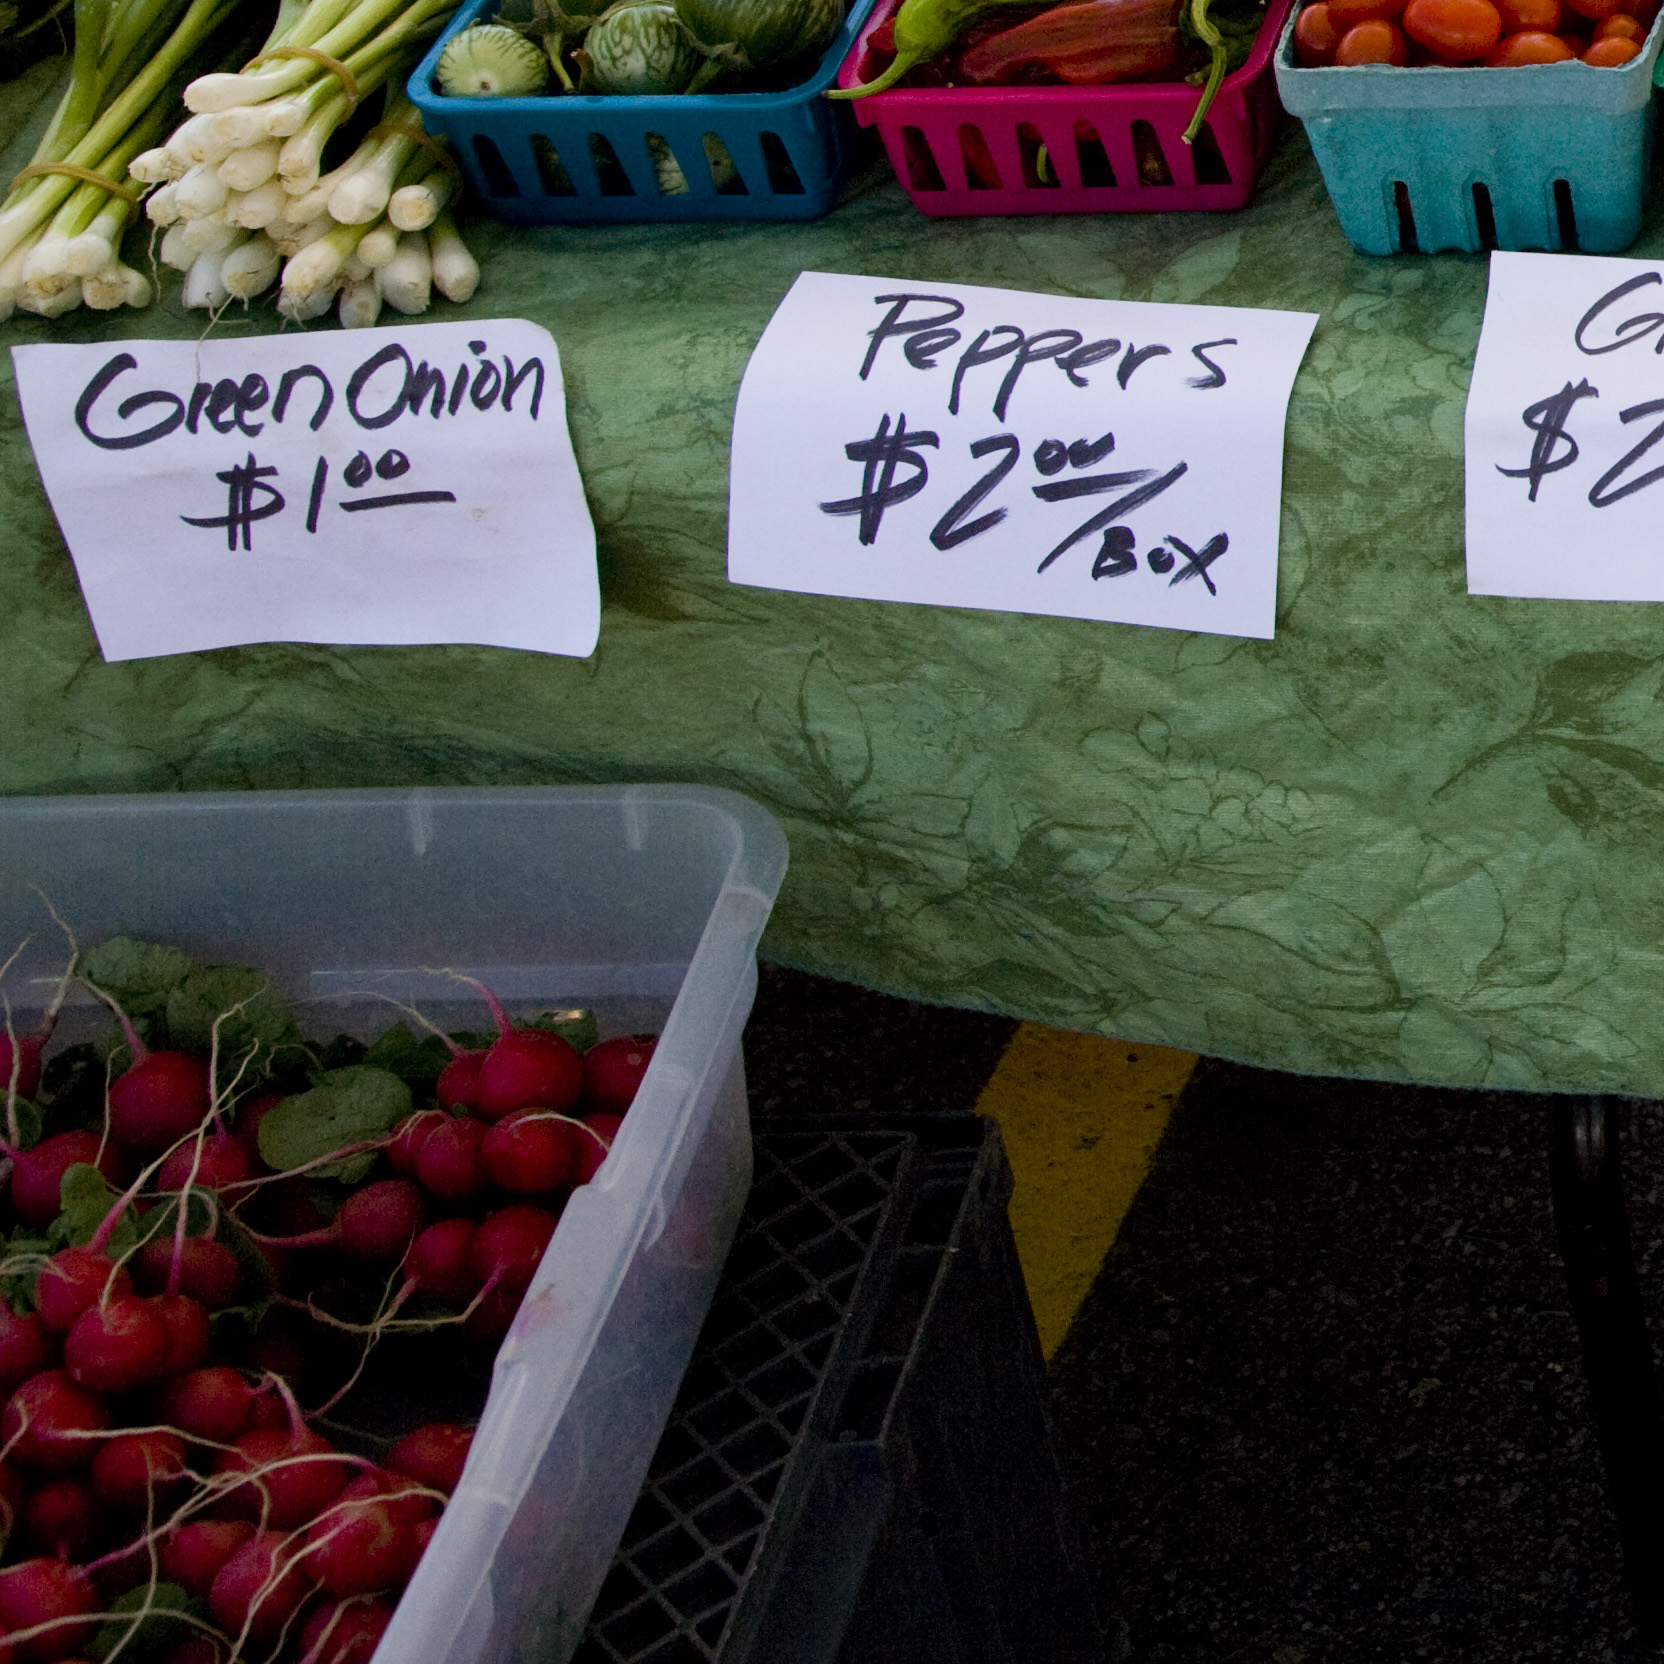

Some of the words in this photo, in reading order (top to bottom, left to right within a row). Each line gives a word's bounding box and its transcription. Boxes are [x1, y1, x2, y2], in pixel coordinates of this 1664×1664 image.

[75, 352, 335, 451] Green
[346, 340, 546, 431] Onion
[858, 291, 1238, 423] Peppers
